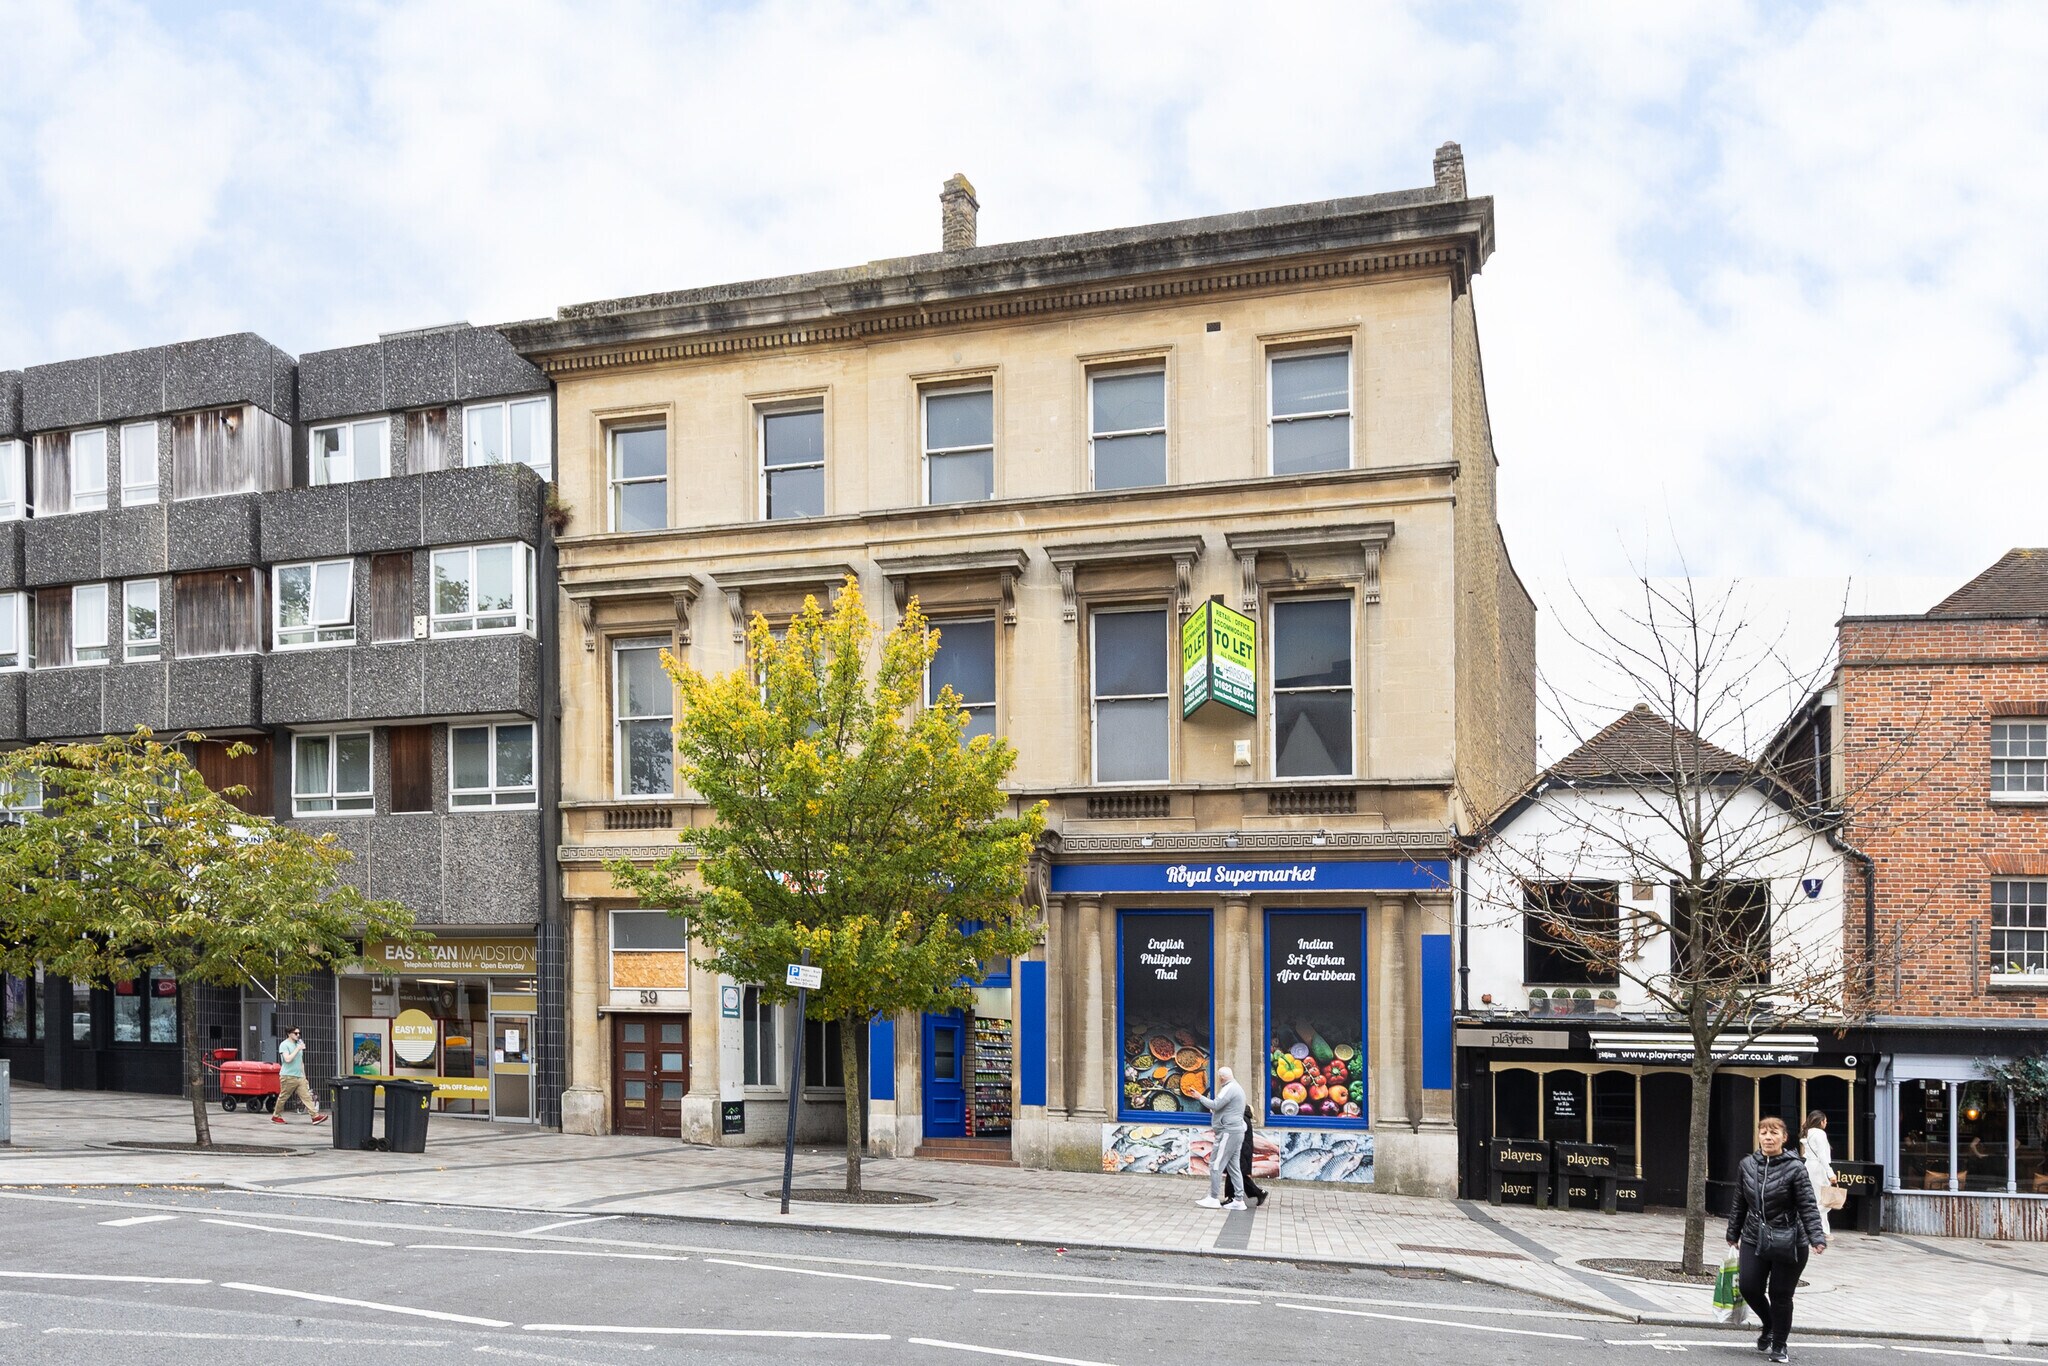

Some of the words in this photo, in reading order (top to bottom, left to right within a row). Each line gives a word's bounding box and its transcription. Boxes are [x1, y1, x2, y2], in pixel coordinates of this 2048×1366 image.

[1216, 609, 1232, 623] RETAIL
[1235, 619, 1251, 632] OFFICE
[1213, 618, 1253, 642] ACCOMMODATION
[1184, 643, 1193, 662] TO
[1194, 630, 1206, 654] LET
[1214, 628, 1230, 650] TO
[1233, 637, 1253, 660] LET
[1166, 865, 1212, 888] Royal
[1214, 865, 1317, 887] Supermarket
[1147, 938, 1184, 952] English
[1298, 938, 1334, 950] Indian
[385, 946, 422, 960] EAS
[428, 945, 458, 960] TAN
[1140, 953, 1192, 967] Philippino
[403, 961, 433, 969] Telephone
[480, 962, 497, 970] Open
[497, 962, 525, 971] Everyday
[1287, 953, 1345, 968] Sri-Lankan
[1155, 968, 1178, 980] Thai
[1276, 969, 1301, 984] Afro
[1302, 969, 1356, 981] Caribbean
[640, 990, 658, 1005] 59
[395, 1025, 415, 1035] EASY
[417, 1026, 433, 1035] TAN
[1491, 1032, 1533, 1047] players
[452, 1083, 463, 1091] OFF
[463, 1084, 488, 1093] Sunday's
[1500, 1148, 1543, 1163] players
[1566, 1152, 1610, 1167] players
[1836, 1170, 1876, 1186] layers
[1501, 1182, 1534, 1196] layer
